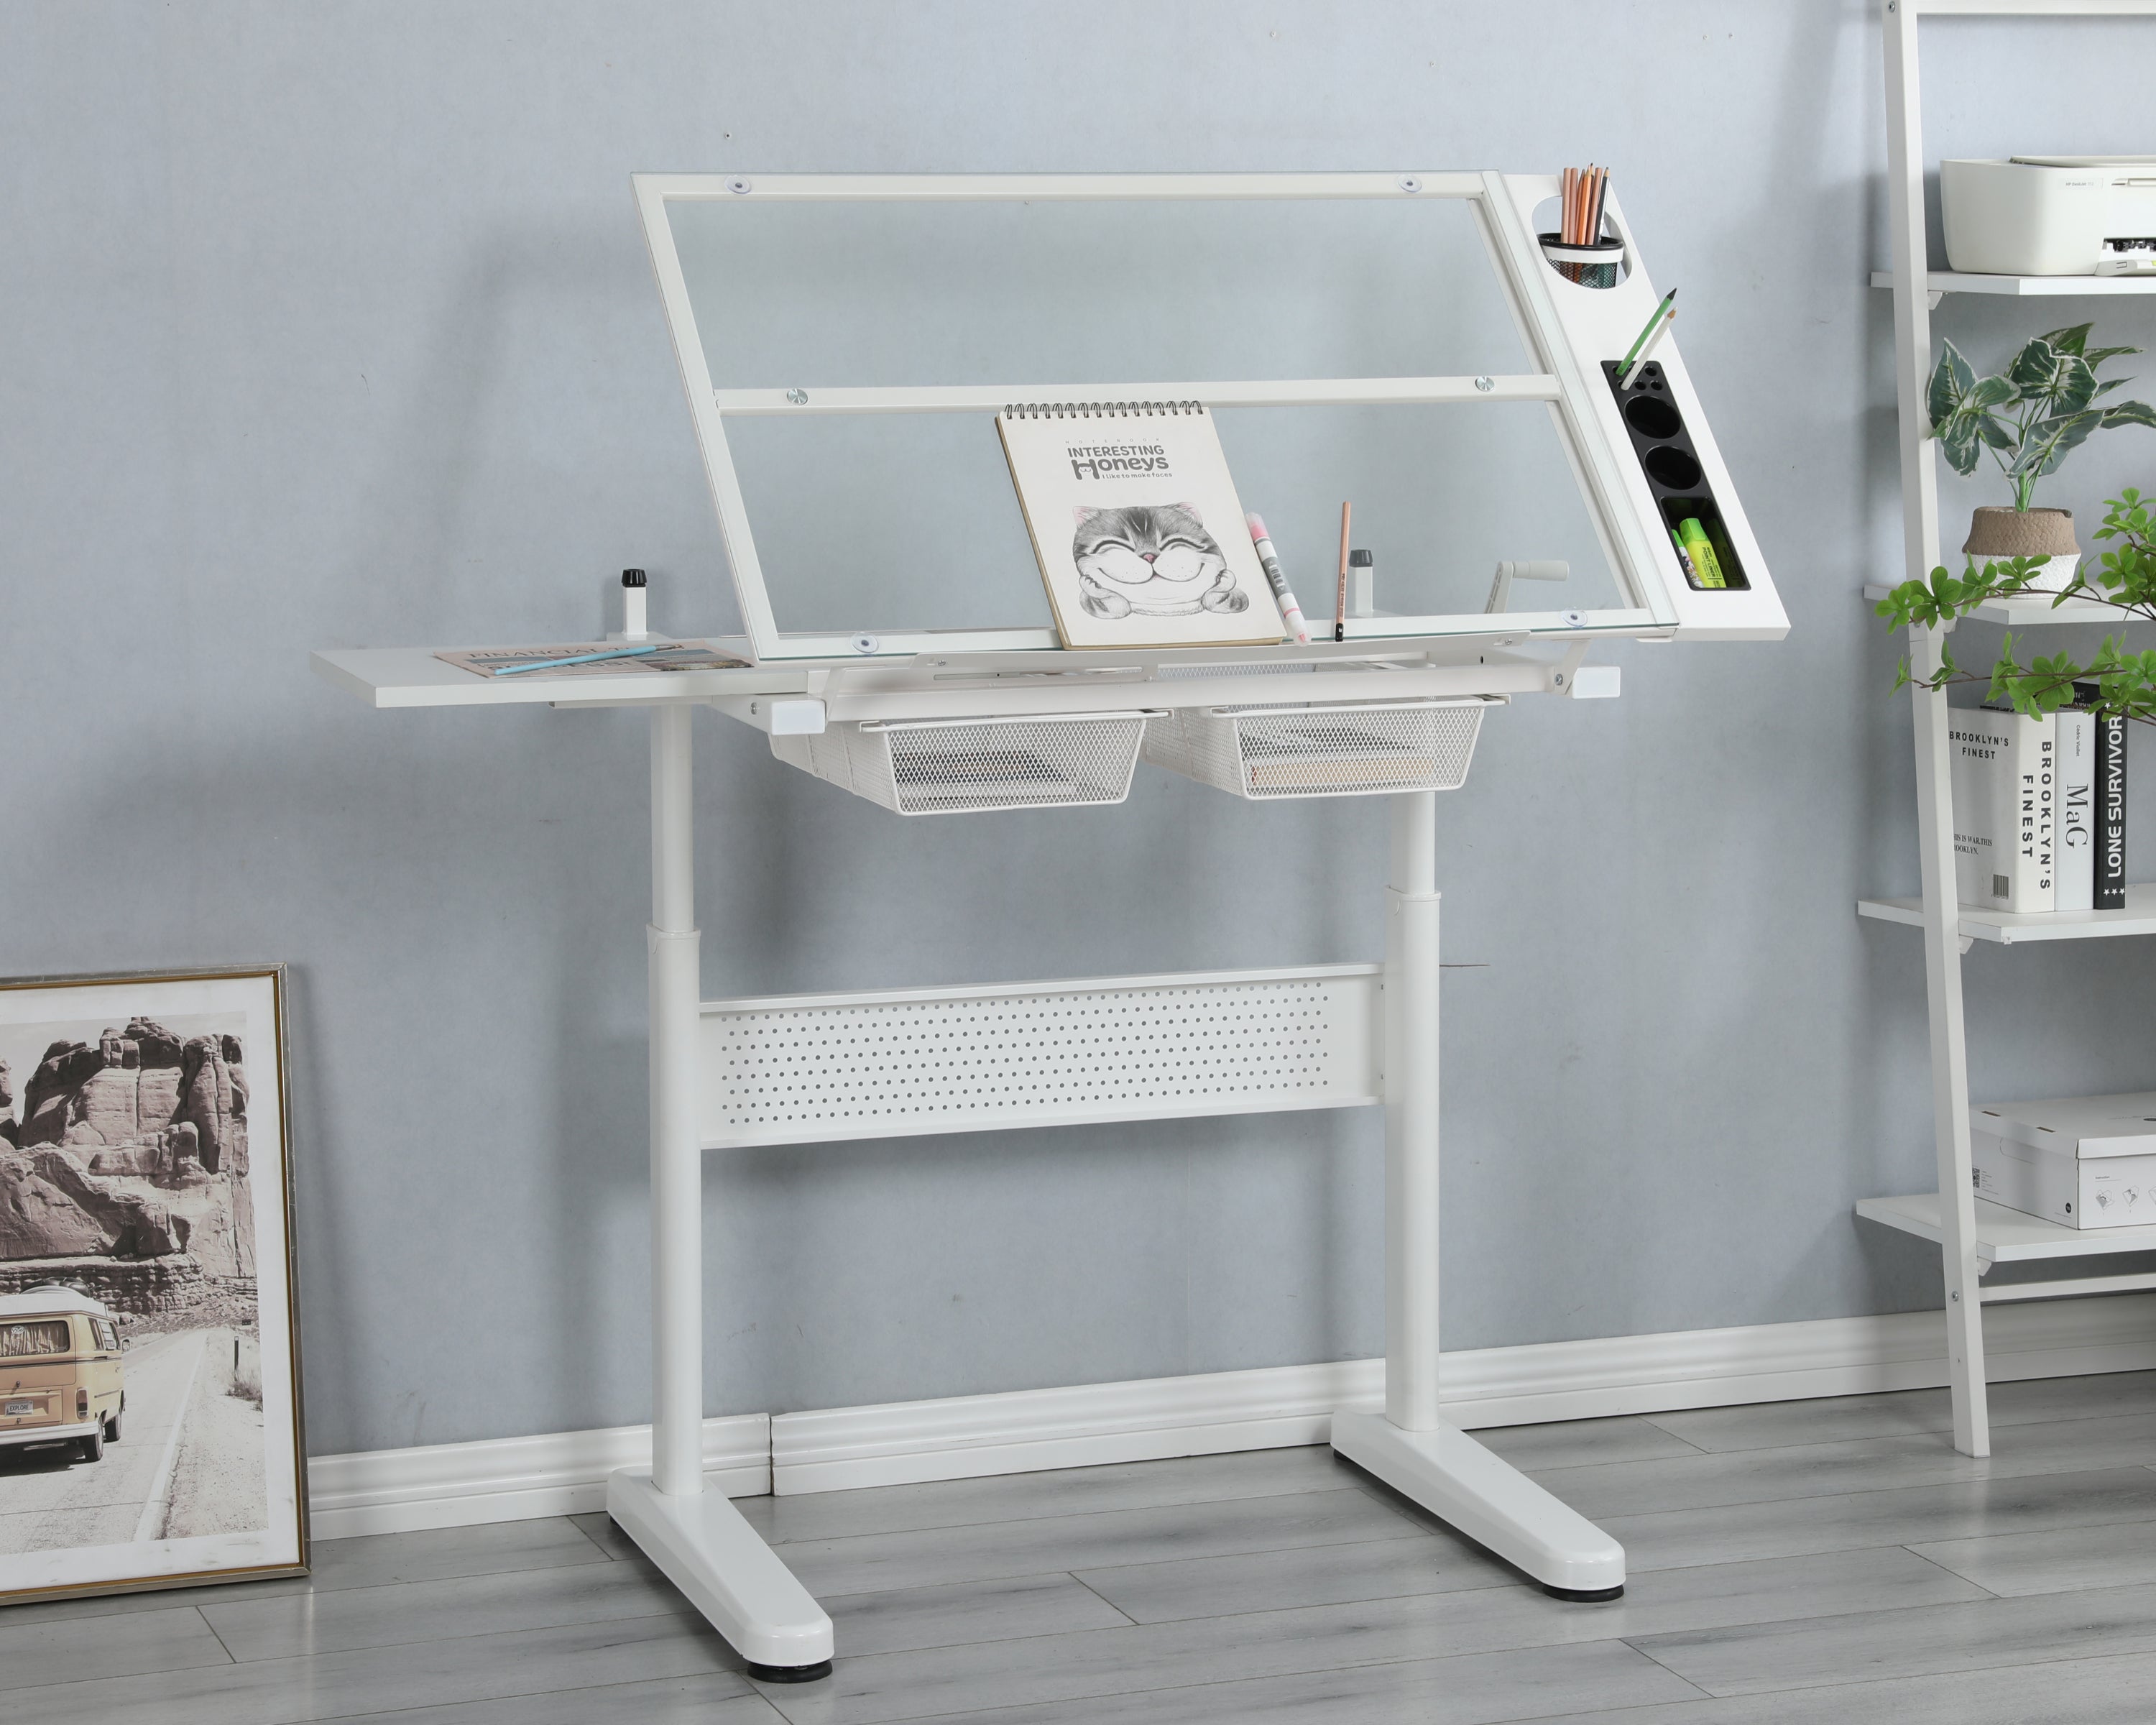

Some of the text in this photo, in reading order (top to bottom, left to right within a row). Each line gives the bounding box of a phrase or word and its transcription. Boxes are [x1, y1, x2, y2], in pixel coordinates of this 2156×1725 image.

[1067, 445, 1164, 457] INTERESTING
[1071, 457, 1169, 480] Honeys
[1949, 731, 2009, 747] BROOKLYN'S
[1962, 747, 1996, 760] FINEST
[2022, 775, 2034, 857] FINEST
[2040, 741, 2052, 890] BROOKLYN'S
[2065, 783, 2088, 849] MaG
[2108, 716, 2123, 878] LONE SURVIVOR
